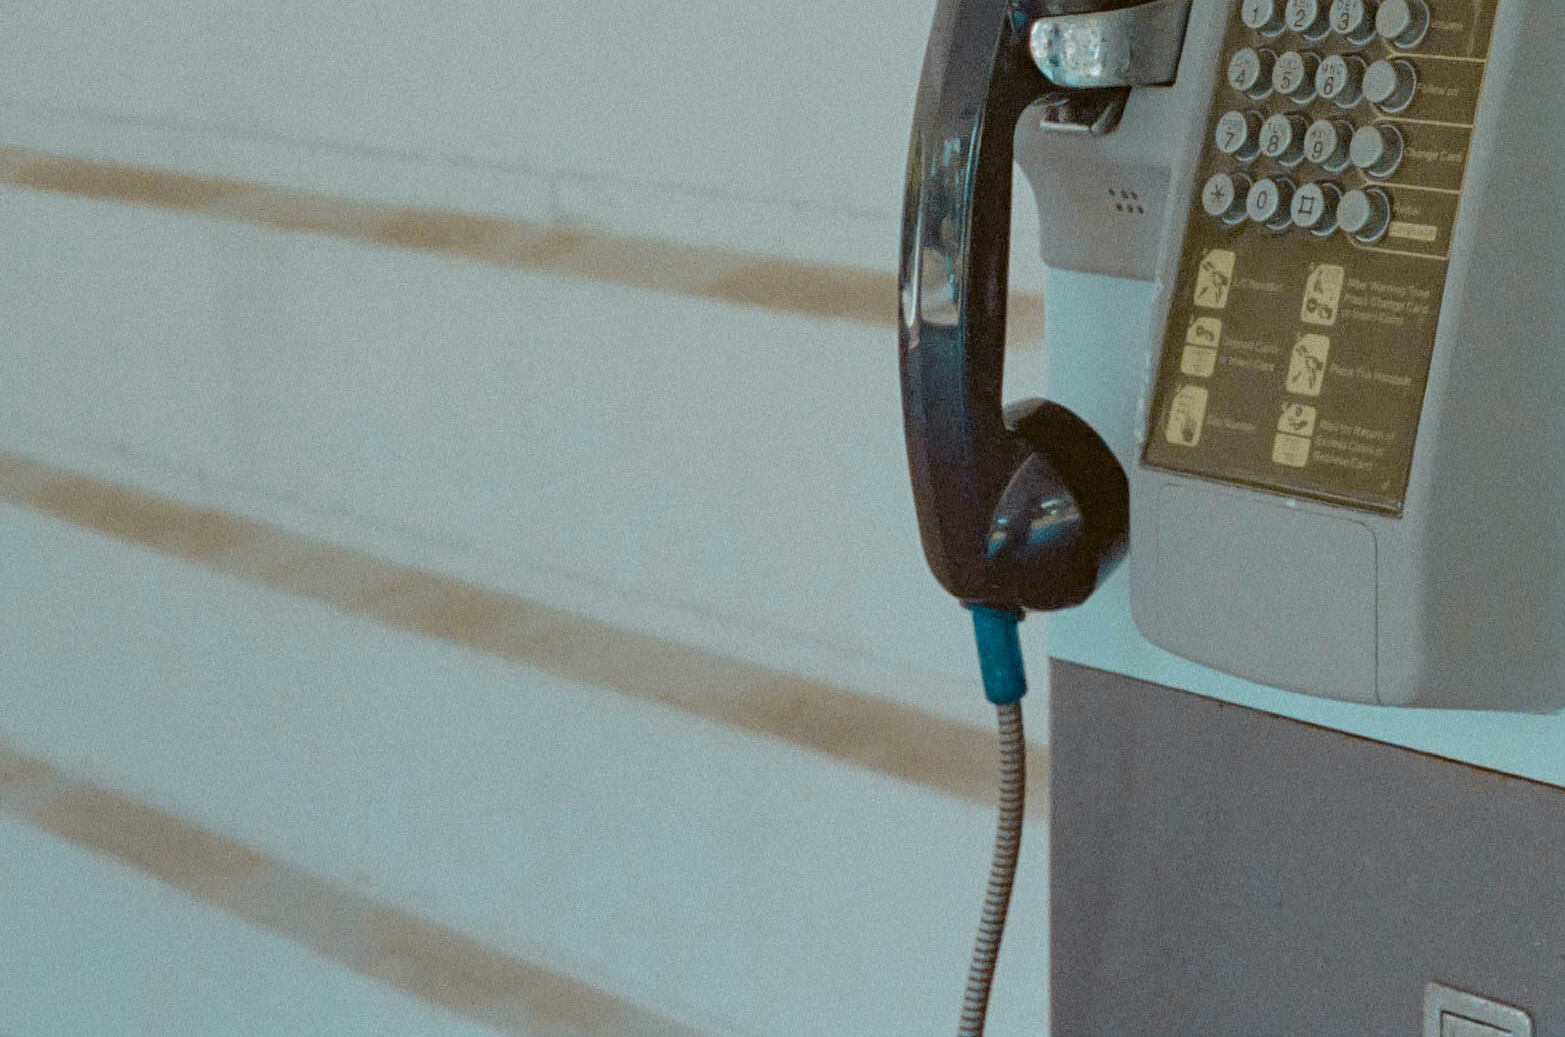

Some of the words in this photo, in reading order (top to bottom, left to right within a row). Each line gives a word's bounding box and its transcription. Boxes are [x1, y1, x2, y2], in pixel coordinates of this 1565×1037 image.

[1252, 6, 1259, 23] 1
[1294, 9, 1306, 27] 2
[1338, 13, 1350, 30] 3
[1234, 70, 1245, 86] 4
[1280, 72, 1292, 89] 5
[1324, 76, 1335, 95] 6
[1224, 132, 1235, 150] 7
[1267, 135, 1279, 153] 8
[1312, 140, 1323, 159] 9
[1256, 191, 1268, 210] 0
